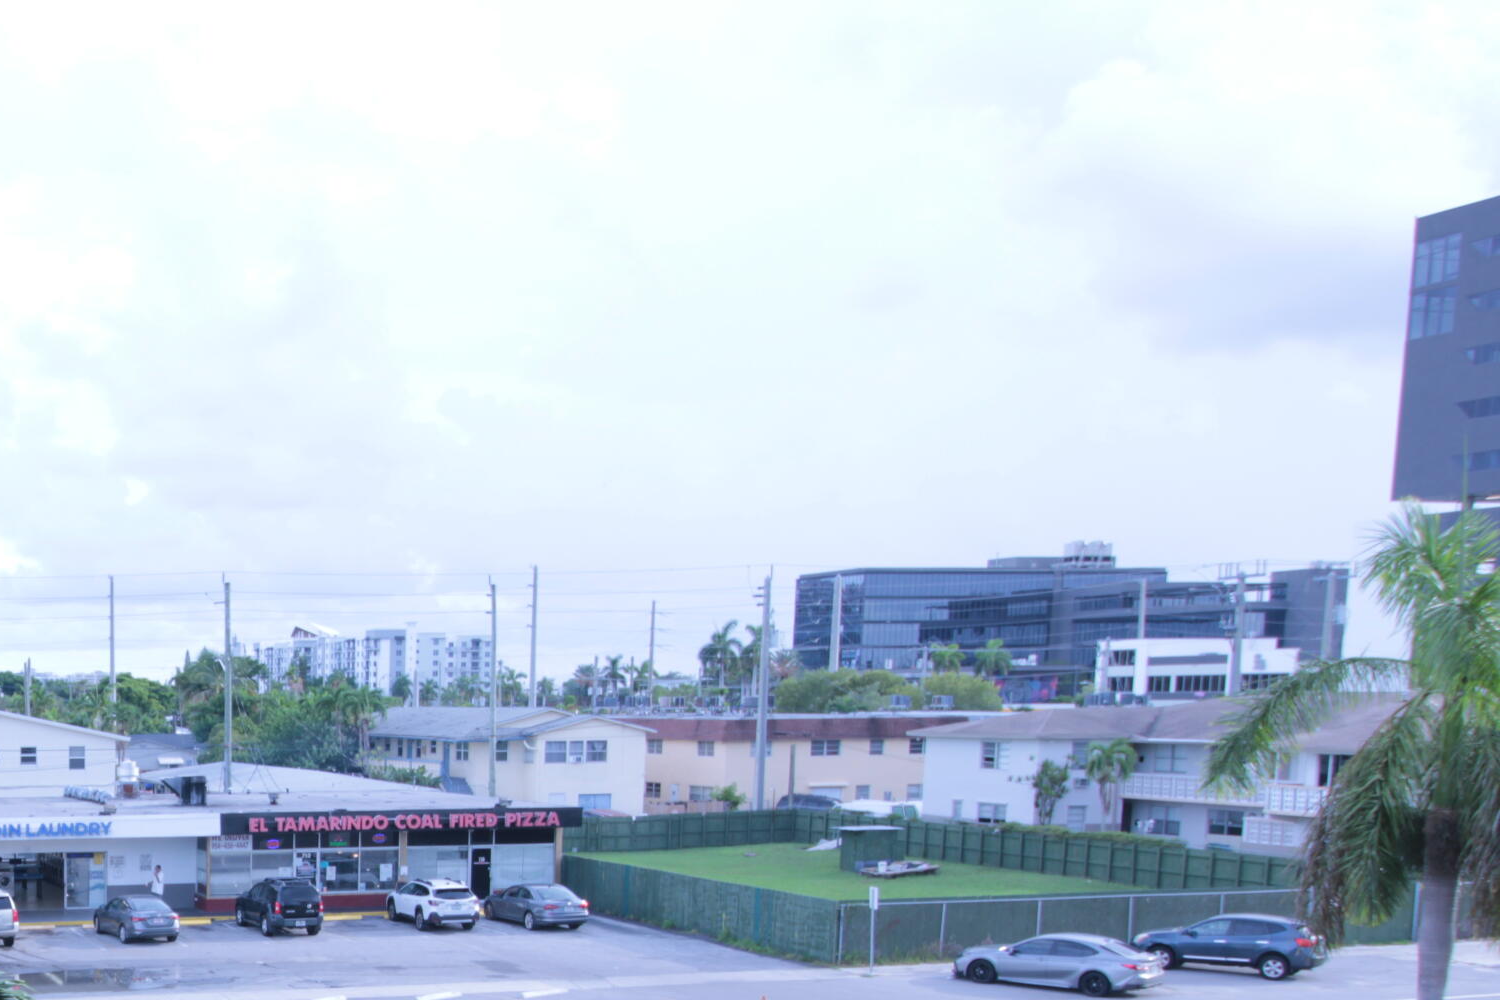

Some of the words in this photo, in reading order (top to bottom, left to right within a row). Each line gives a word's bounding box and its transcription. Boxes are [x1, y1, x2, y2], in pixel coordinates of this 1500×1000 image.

[25, 821, 112, 837] LAUNDRY
[249, 817, 268, 832] EL
[275, 815, 389, 831] TAMARINDO
[394, 814, 443, 829] COAL
[449, 812, 498, 828] FIRED
[504, 811, 560, 827] PIZZA
